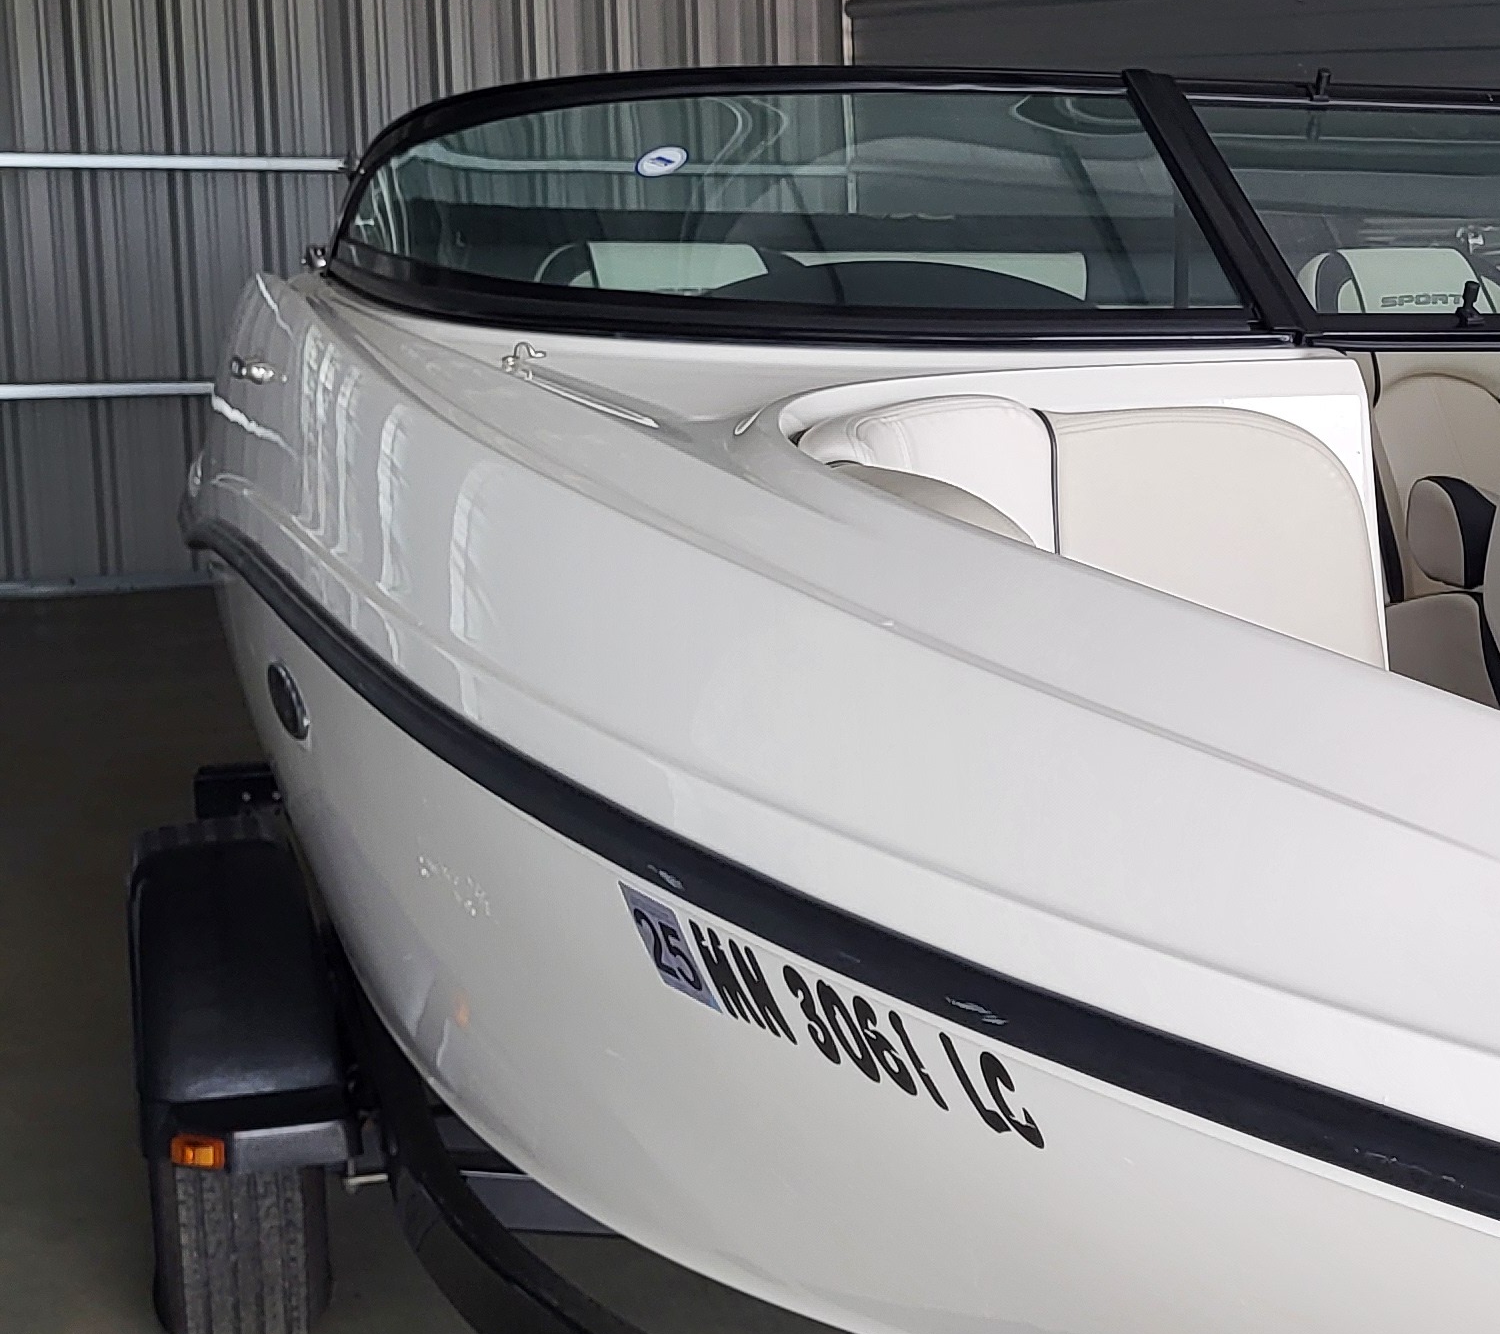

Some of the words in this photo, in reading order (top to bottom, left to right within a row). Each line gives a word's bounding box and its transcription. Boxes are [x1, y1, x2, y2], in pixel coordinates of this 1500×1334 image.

[1380, 292, 1465, 308] SPORT
[633, 907, 703, 992] 25
[782, 964, 950, 1112] 3061
[938, 1031, 1046, 1150] LC
